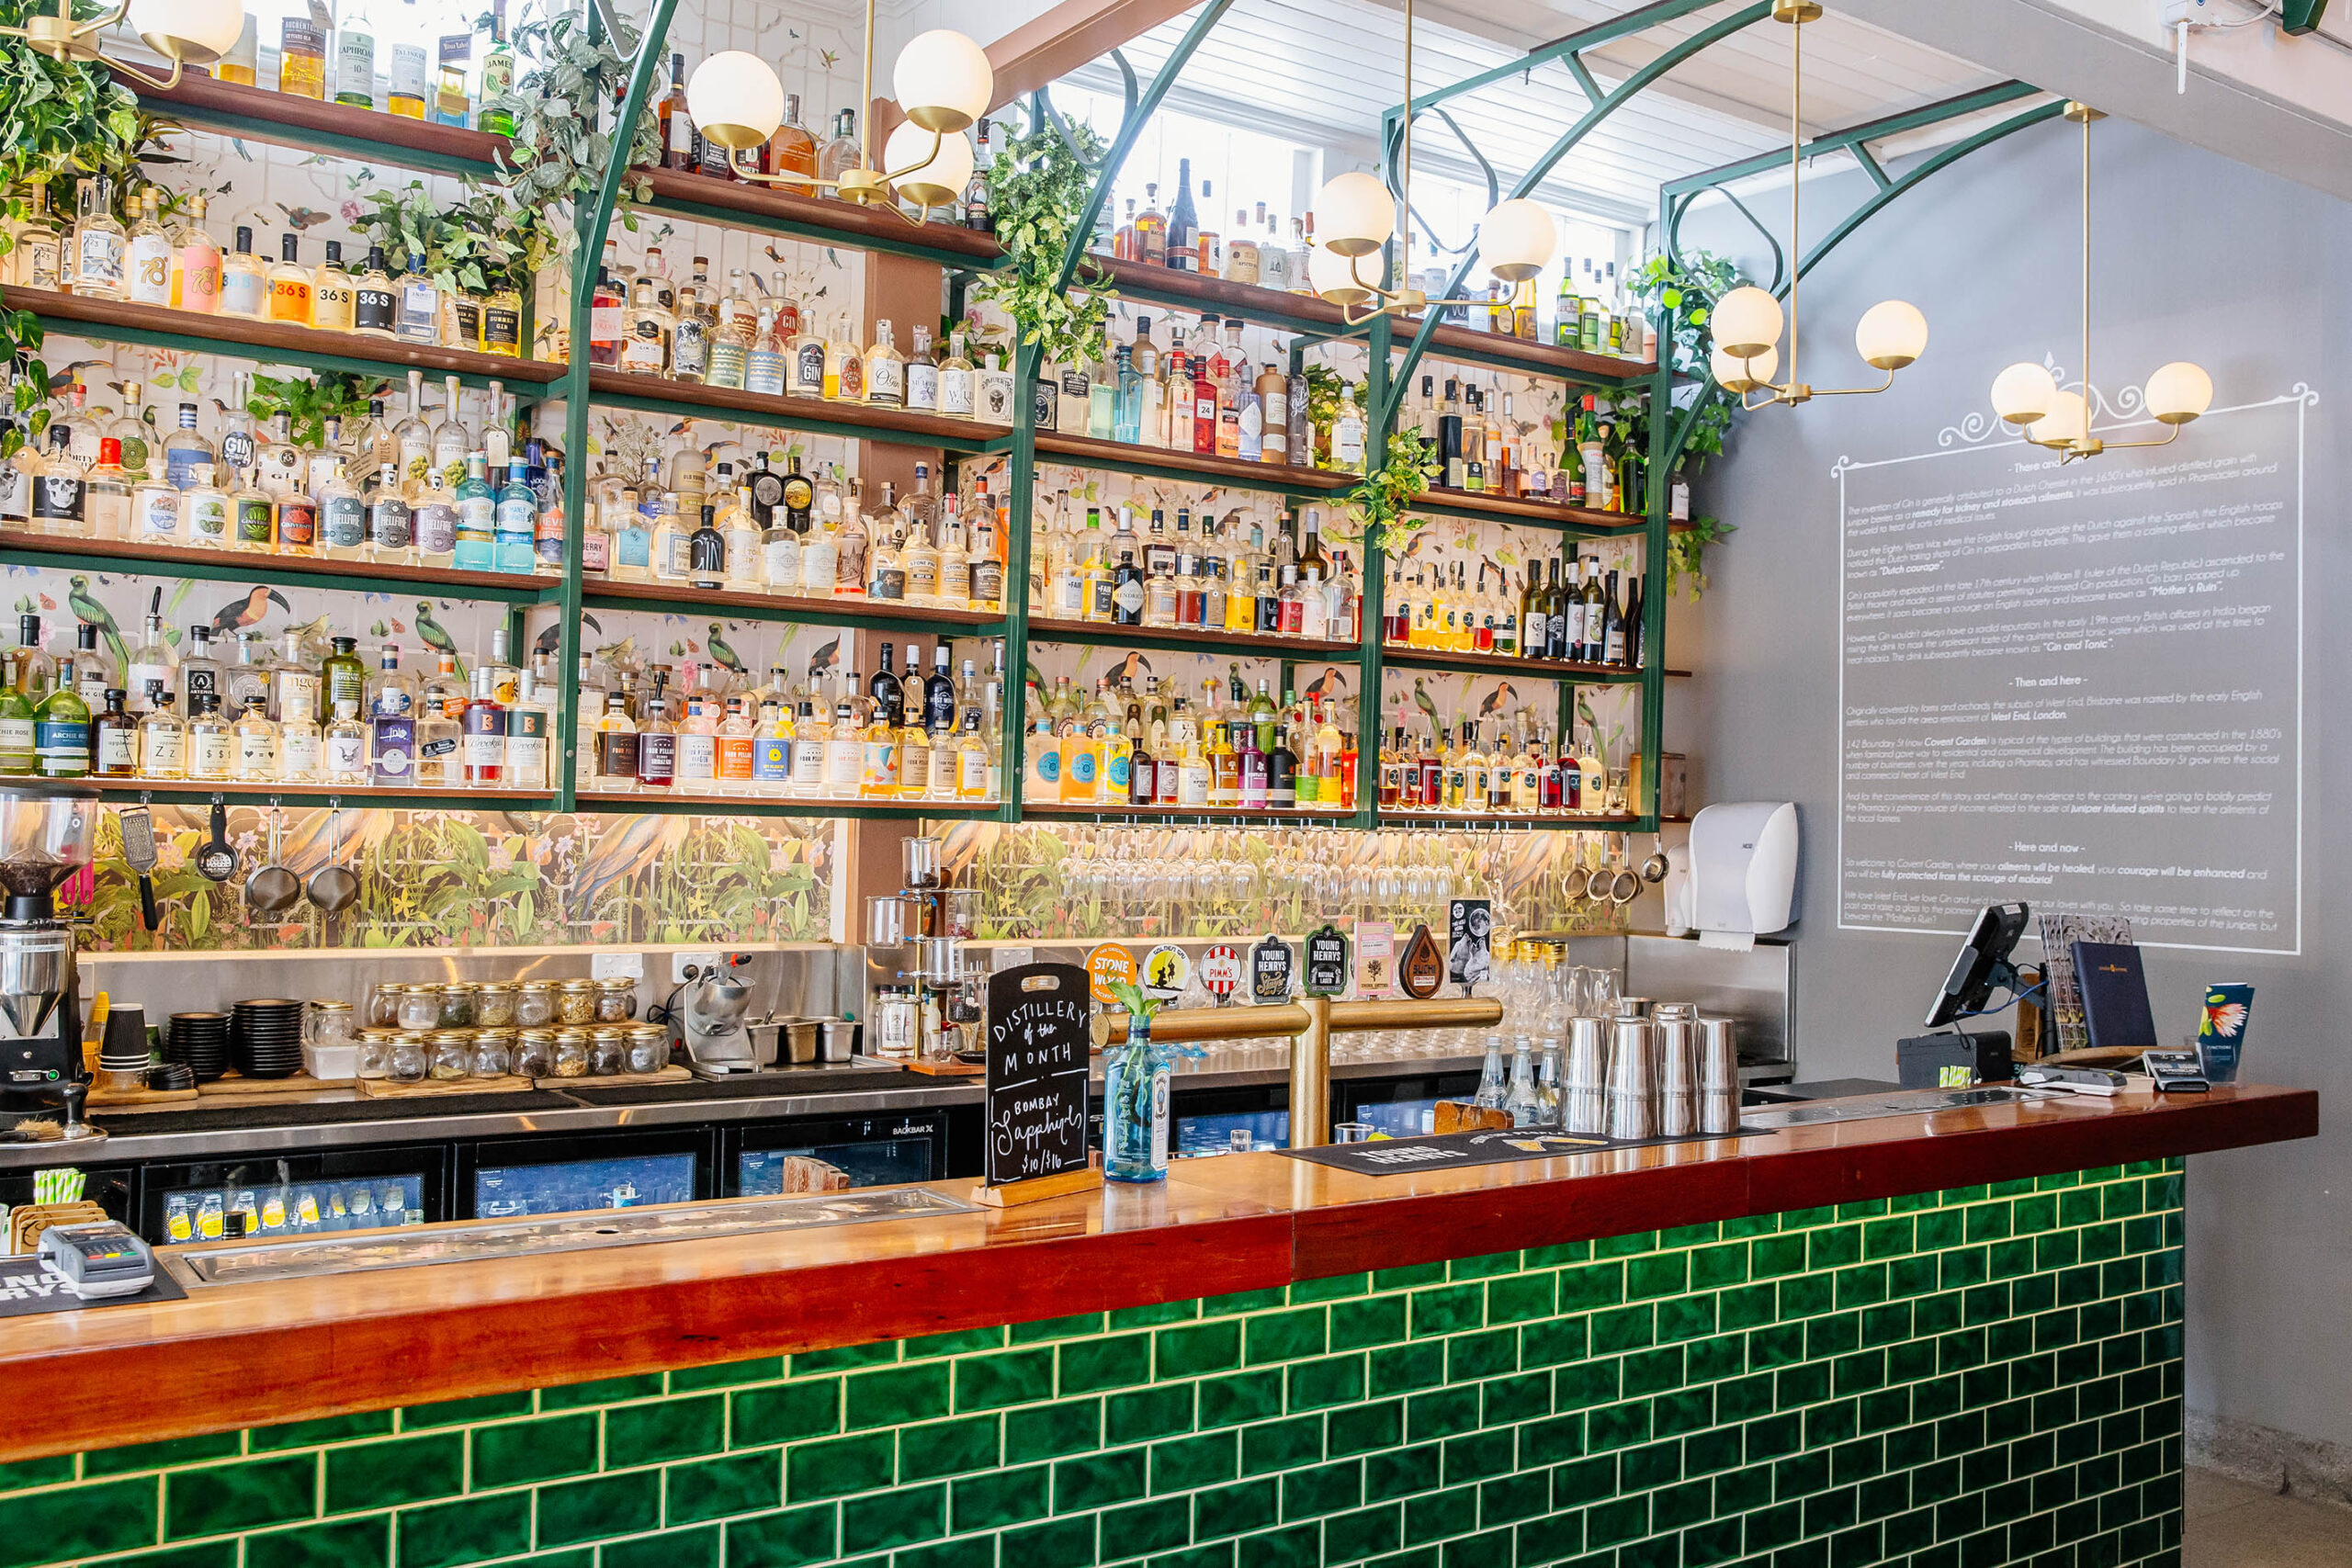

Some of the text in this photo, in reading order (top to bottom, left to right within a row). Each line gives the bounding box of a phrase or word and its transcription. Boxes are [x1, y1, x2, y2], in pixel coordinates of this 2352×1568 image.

[353, 65, 362, 73] 10
[277, 284, 306, 298] 36 S
[320, 289, 348, 303] 36 S
[359, 292, 389, 307] 36 S
[490, 315, 514, 323] SUMMER
[781, 314, 796, 331] GIN
[803, 365, 821, 382] GIN
[1201, 405, 1210, 414] 24
[225, 436, 252, 453] GIN
[2014, 455, 2061, 472] There and
[1912, 507, 1940, 517] remedy
[1955, 502, 1980, 511] kidney
[1982, 498, 2000, 508] and
[333, 512, 361, 527] HELLFIRE
[380, 514, 407, 529] HELLFIRE
[426, 519, 452, 533] HELLFIRE
[2063, 641, 2081, 650] and
[2014, 675, 2081, 686] Then and here
[481, 714, 493, 731] B
[1991, 712, 2011, 720] West
[523, 716, 536, 733] B
[1924, 737, 1953, 746] Covent
[155, 745, 164, 757] Z
[207, 749, 224, 758] $ $
[2014, 841, 2036, 851] Here
[2038, 842, 2057, 851] and
[1881, 869, 1896, 879] fully
[1957, 872, 1970, 880] the
[1972, 875, 2005, 883] scourge
[2007, 874, 2016, 882] of
[2047, 863, 2060, 872] be
[2117, 867, 2158, 876] courage
[2160, 866, 2175, 875] will
[2177, 866, 2191, 876] be
[2192, 867, 2245, 878] enhanced
[2246, 870, 2267, 879] and
[1316, 940, 1340, 950] YOUNG
[1261, 950, 1285, 960] YOUNG
[1313, 950, 1341, 961] HENRYS
[1094, 957, 1129, 974] STONE
[1209, 967, 1233, 978] PIMM'S
[1258, 961, 1286, 972] HENRYS
[993, 1000, 1087, 1042] DISTILLERY
[1023, 1023, 1033, 1045] of
[1005, 1043, 1071, 1075] MONTH
[1014, 1093, 1059, 1115] BOMBAY
[893, 1126, 925, 1135] BACKBAR
[1350, 1145, 1440, 1157] YOUNG
[1366, 1150, 1468, 1164] HENRYS
[1022, 1150, 1062, 1174] $10/$16
